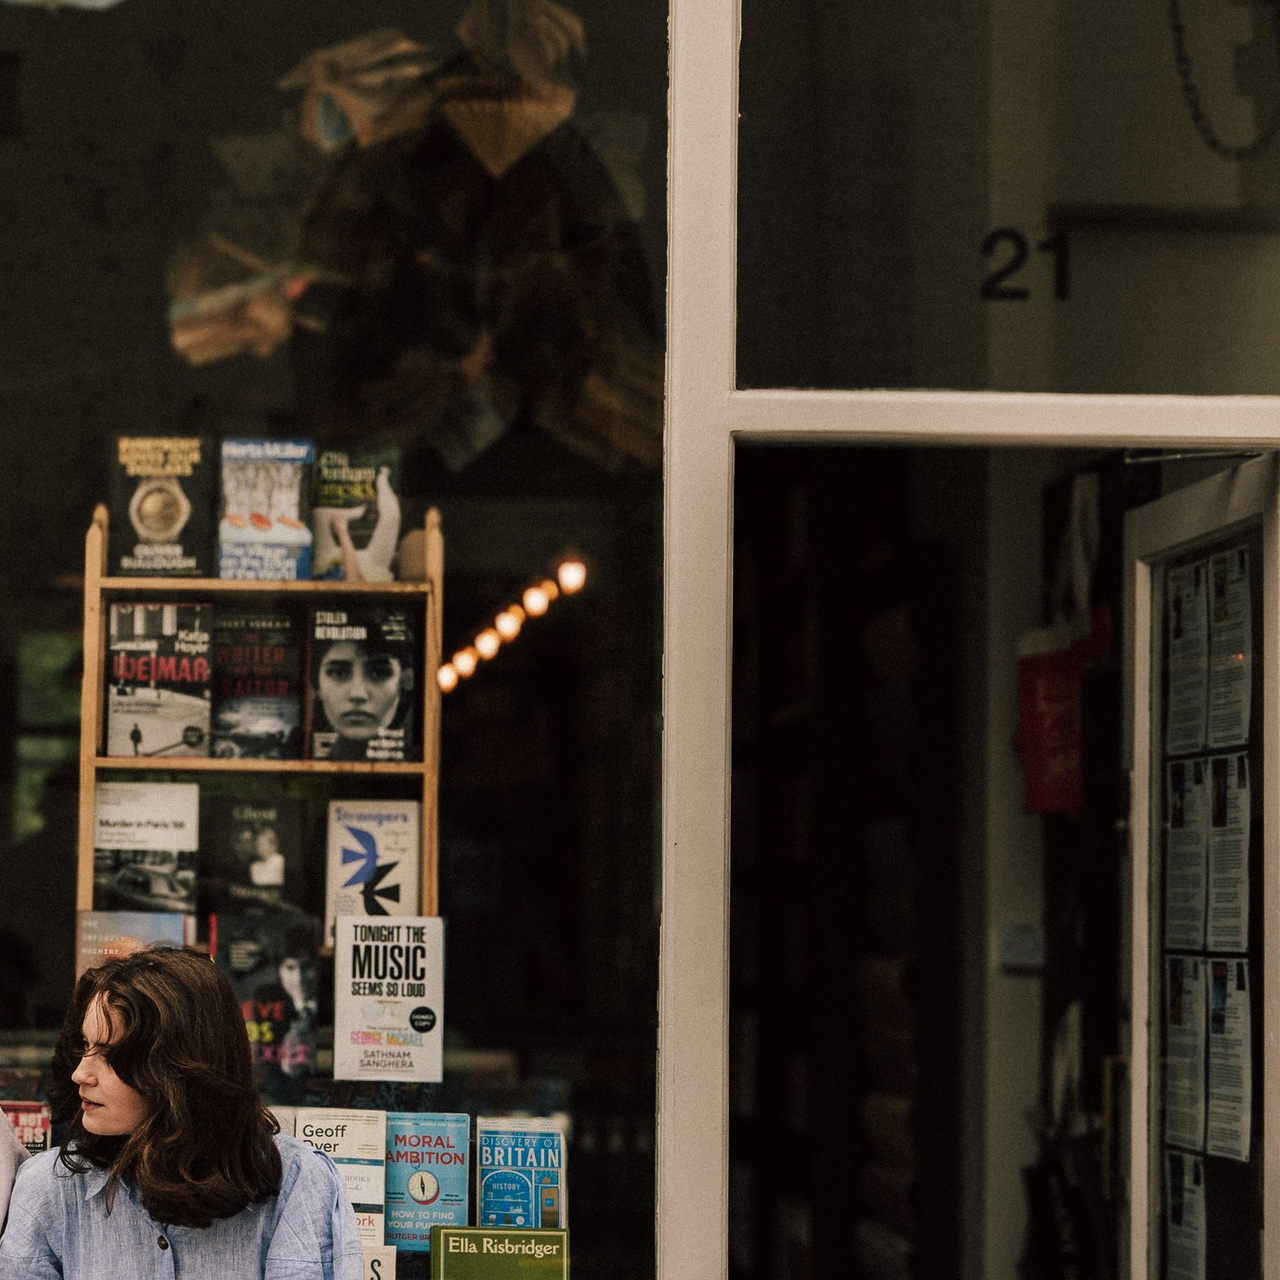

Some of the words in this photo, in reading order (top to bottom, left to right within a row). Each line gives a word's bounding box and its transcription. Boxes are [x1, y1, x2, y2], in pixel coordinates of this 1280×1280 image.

[979, 228, 1068, 301] 21
[113, 655, 208, 682] WEIMAR
[353, 924, 402, 943] TONIGHT
[406, 925, 426, 943] THE
[351, 944, 426, 981] MUSIC
[351, 982, 384, 997] SEEMS
[386, 982, 399, 997] SO
[401, 983, 425, 998] LOUD
[363, 1050, 411, 1059] SATHNAM
[359, 1059, 415, 1069] SANGHERA
[302, 1124, 347, 1138] Geoff
[394, 1133, 456, 1149] MORAL
[481, 1137, 538, 1147] DISCOVERY
[543, 1138, 560, 1148] OF
[385, 1150, 466, 1166] AMBITION
[481, 1146, 560, 1168] BRITAIN
[492, 1183, 520, 1191] HISTORY
[391, 1210, 415, 1220] HOW
[417, 1210, 430, 1220] TO
[432, 1211, 455, 1220] FIND
[387, 1220, 414, 1229] YOUR
[386, 1231, 418, 1241] RUTGER
[448, 1236, 478, 1254] Ella
[482, 1237, 560, 1259] Risbridger
